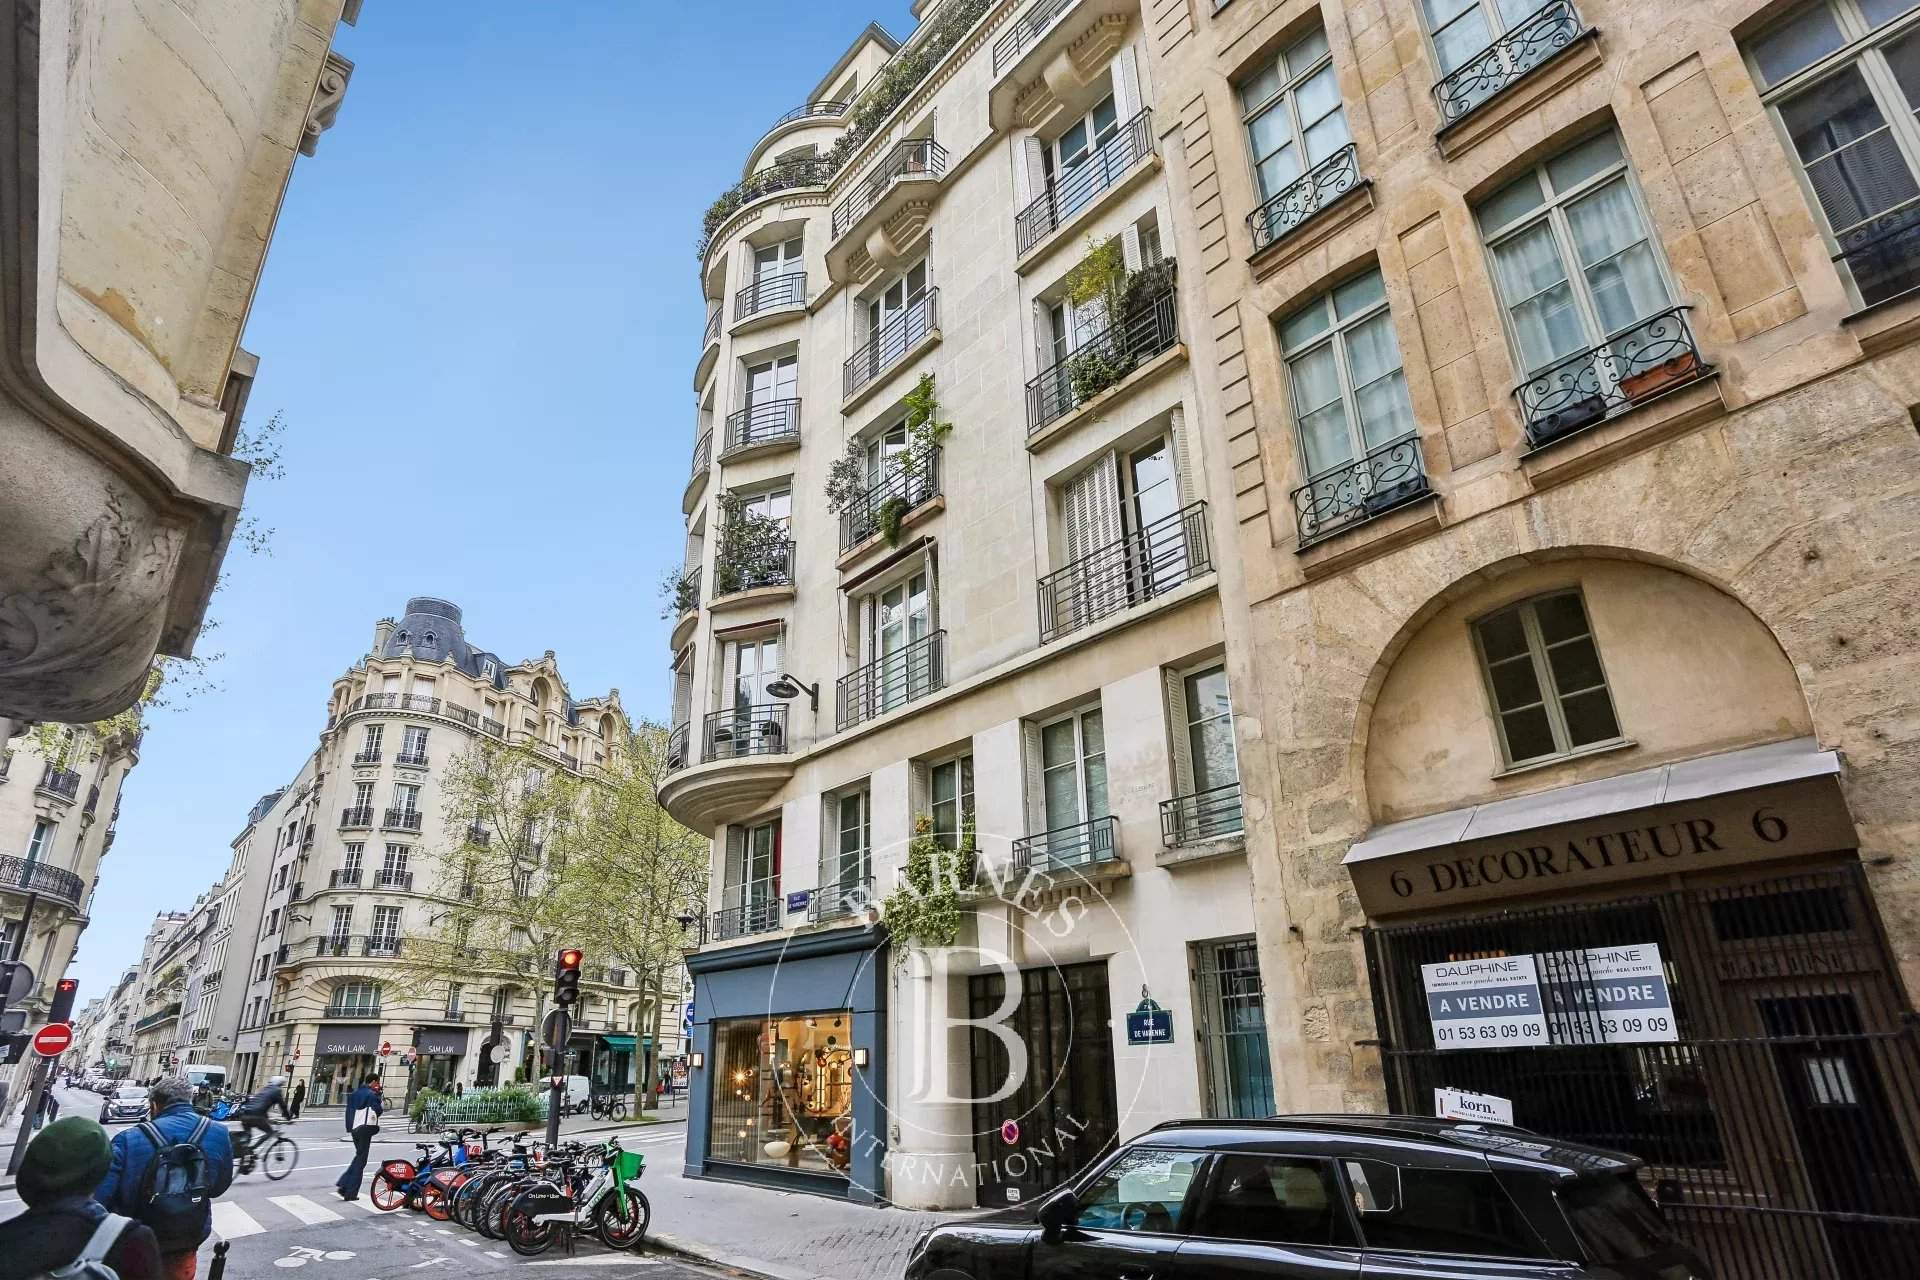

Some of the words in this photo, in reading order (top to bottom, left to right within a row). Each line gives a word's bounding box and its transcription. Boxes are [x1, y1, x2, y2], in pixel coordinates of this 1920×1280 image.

[1390, 869, 1413, 898] 6
[1426, 816, 1724, 894] DECORATEUR
[1751, 806, 1789, 844] 6
[1435, 961, 1519, 978] DAUPHINE
[1440, 999, 1452, 1013] A
[1456, 993, 1530, 1012] VENDRE
[1573, 984, 1655, 1004] VENDRE
[1143, 1018, 1155, 1026] RUE
[1600, 1019, 1618, 1033] 63
[1622, 1018, 1642, 1033] 09
[1648, 1017, 1668, 1032] 09
[1438, 1028, 1454, 1041] 01
[1459, 1026, 1476, 1040] 53
[1480, 1025, 1497, 1039] 63
[1501, 1024, 1518, 1038] 09
[1522, 1023, 1541, 1037] 09
[327, 1044, 345, 1053] SAM
[1460, 1096, 1496, 1115] korn.
